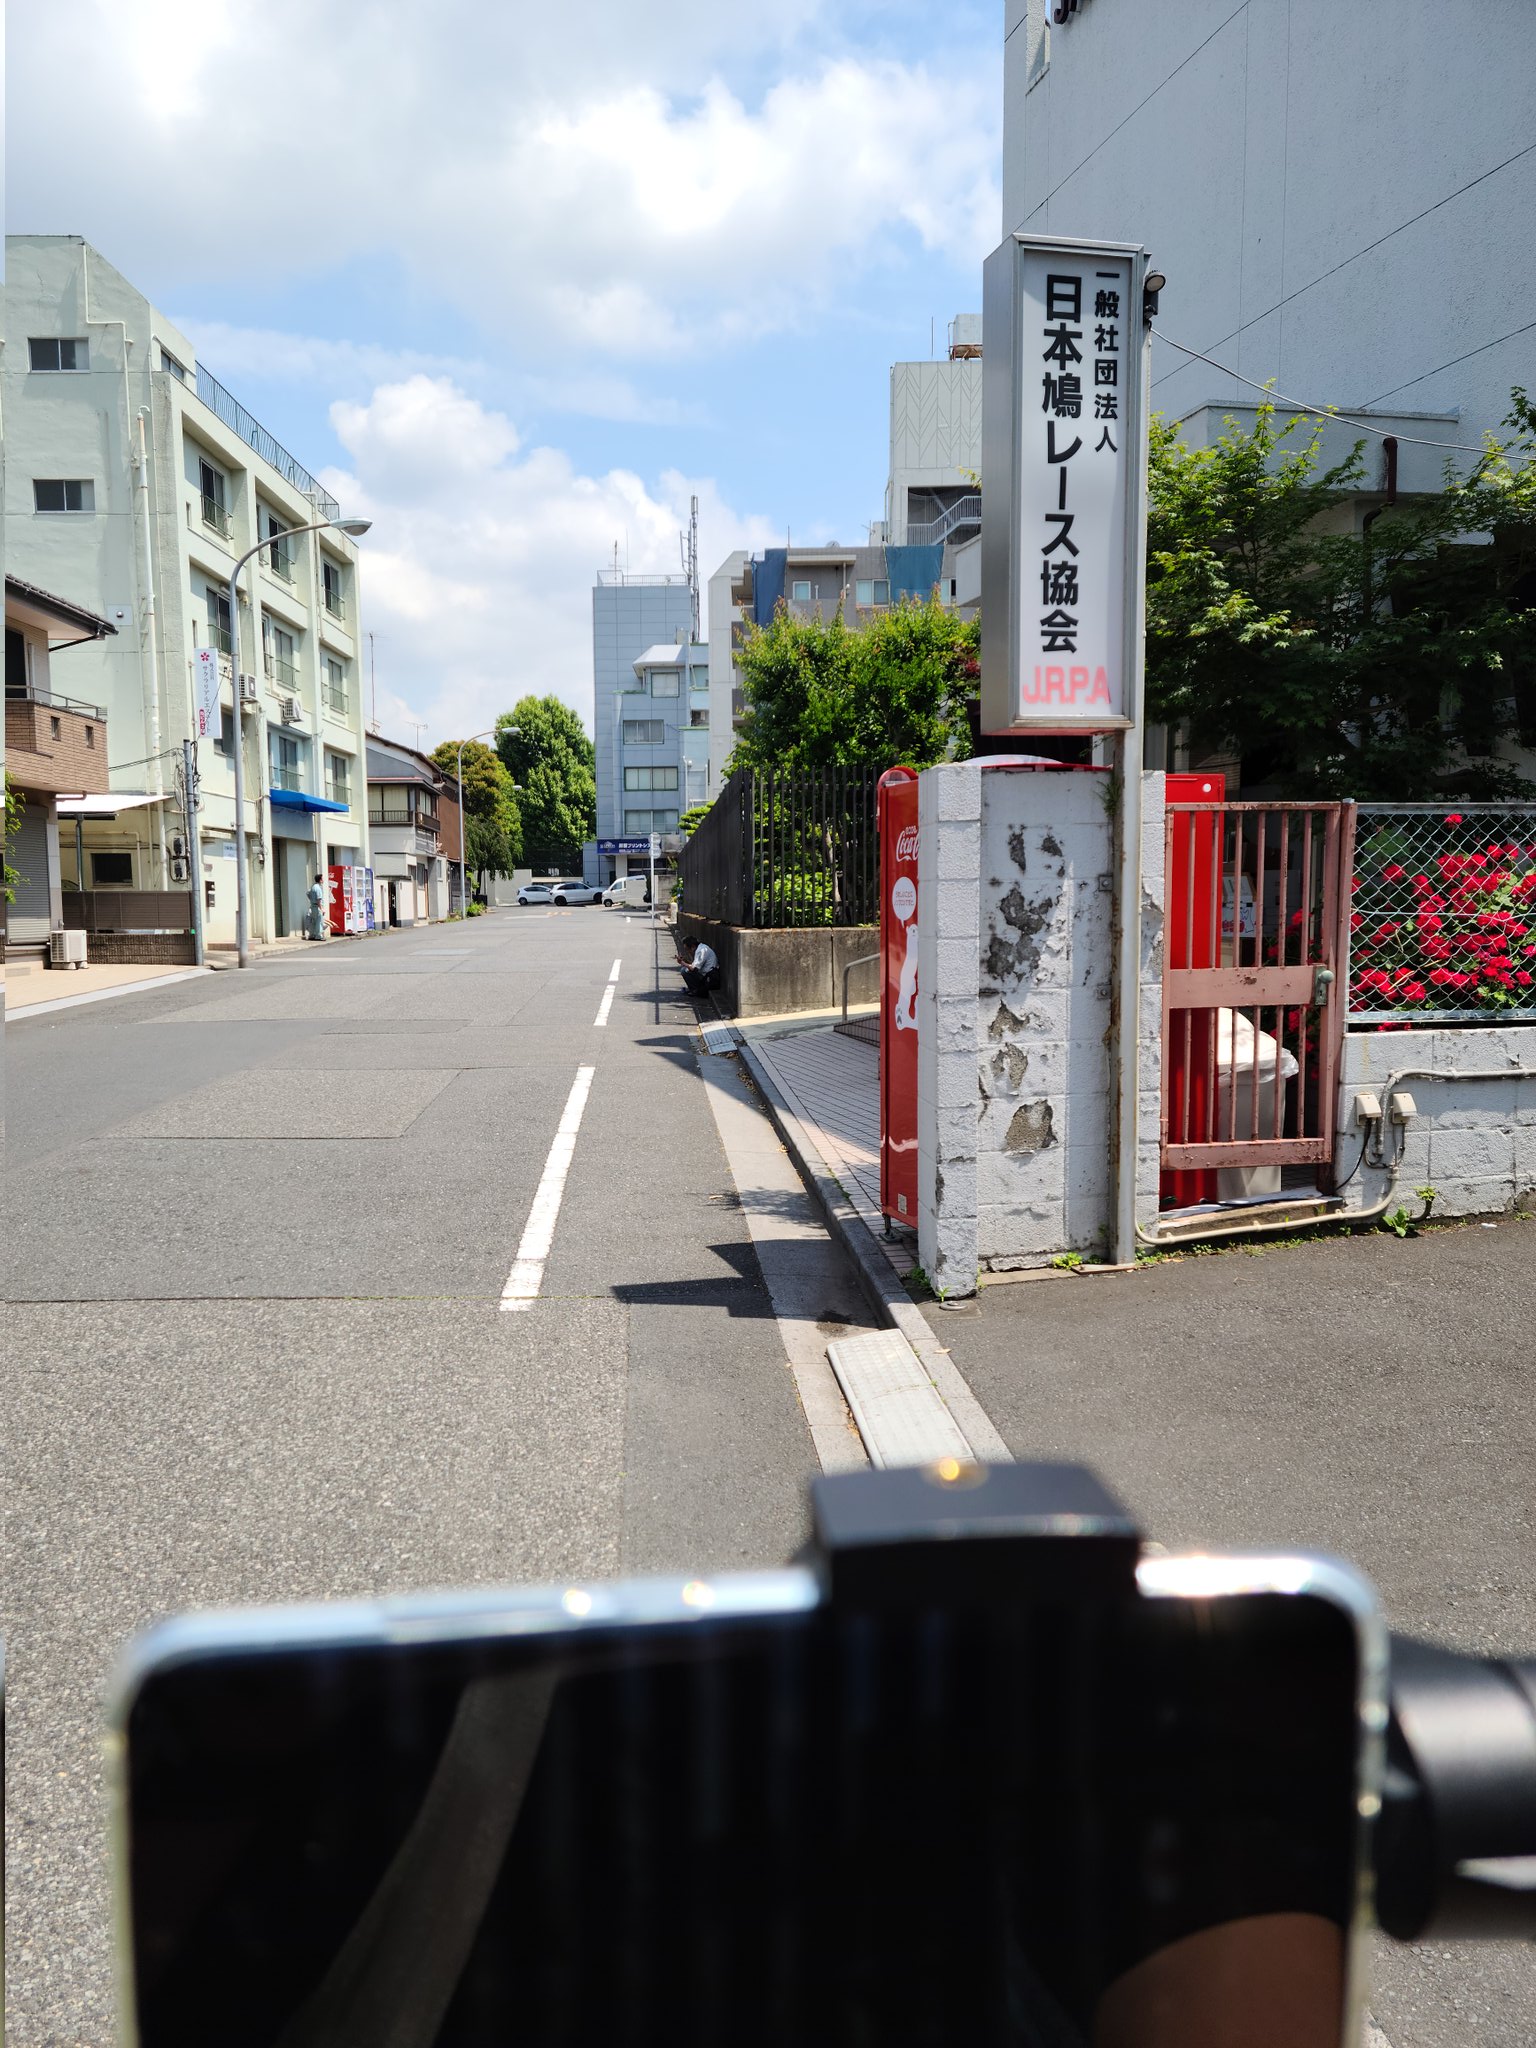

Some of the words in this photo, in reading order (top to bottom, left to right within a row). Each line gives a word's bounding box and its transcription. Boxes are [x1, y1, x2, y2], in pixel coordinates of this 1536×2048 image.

[1040, 274, 1083, 654] 日本鳩レース協会
[1094, 271, 1120, 453] 一般社団法人
